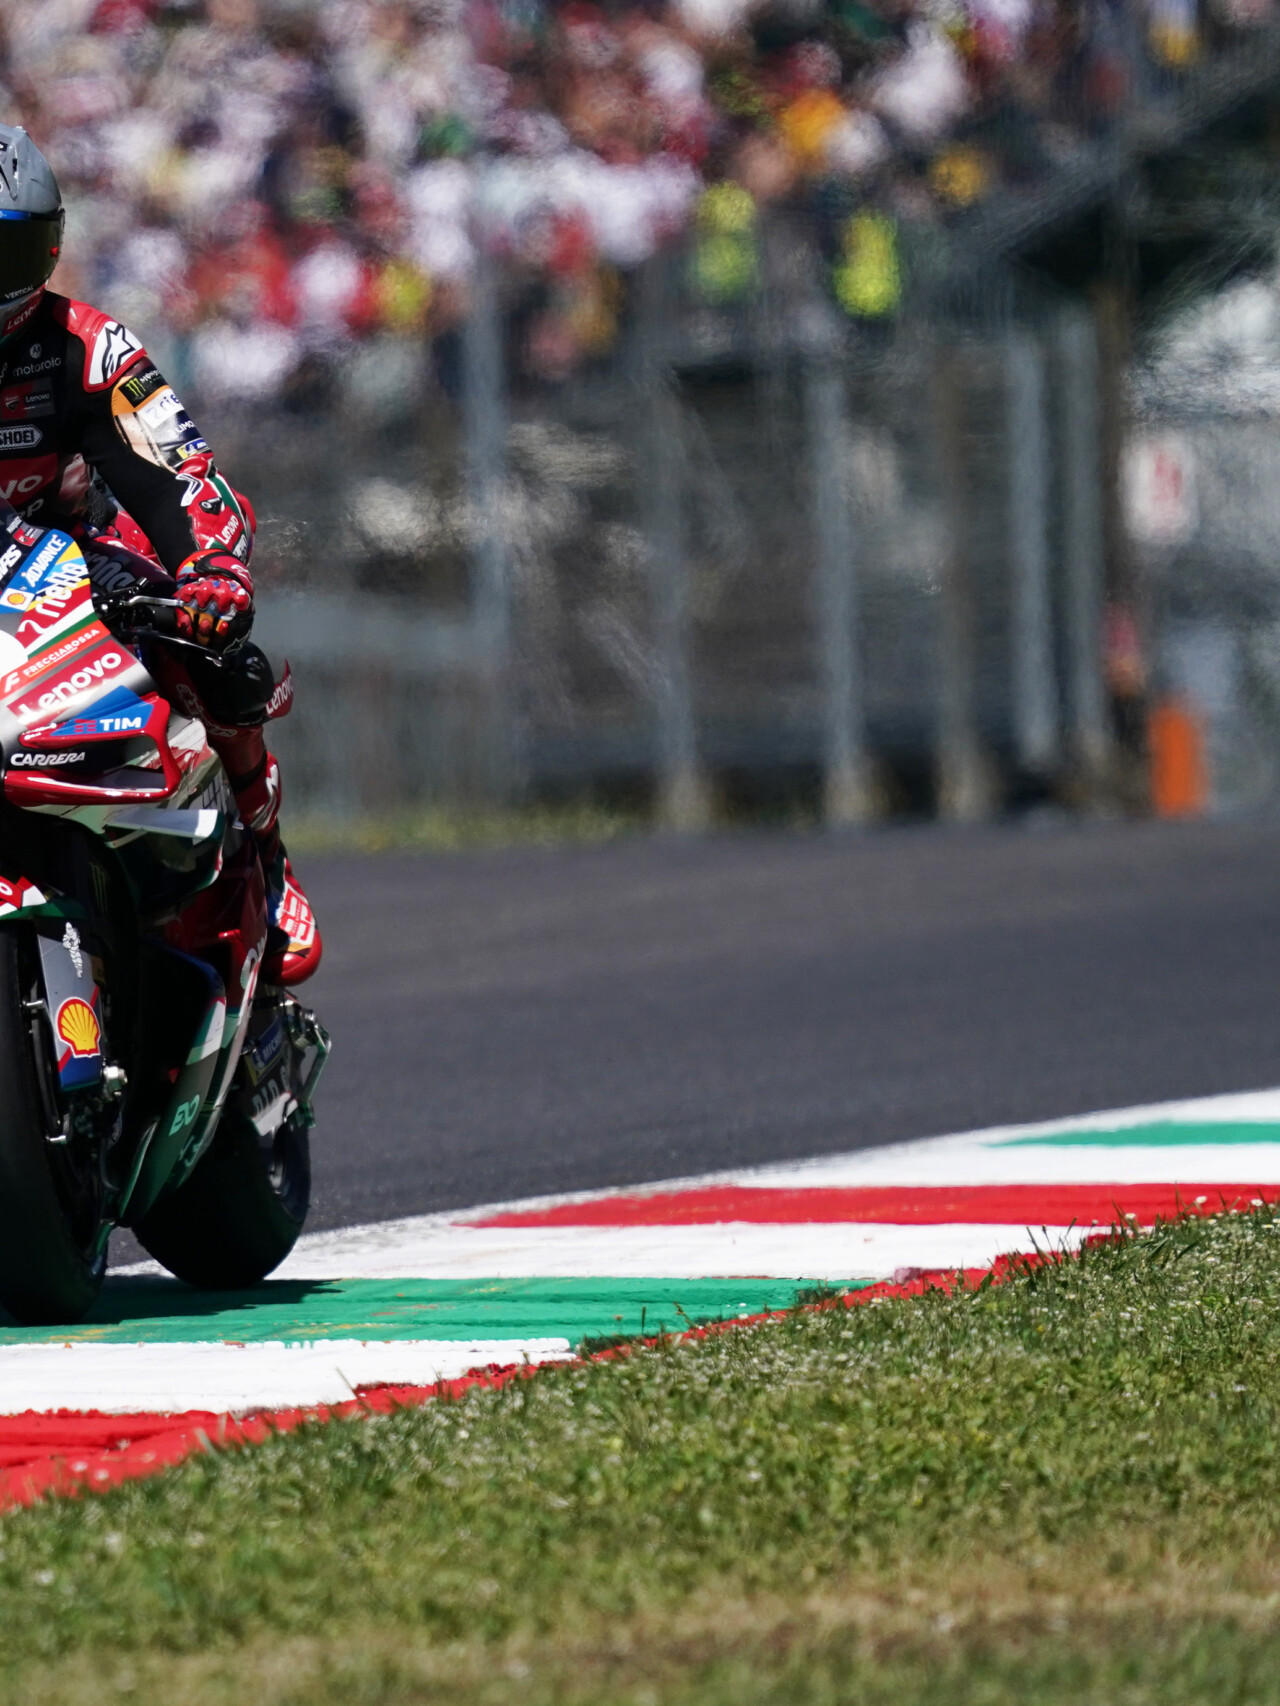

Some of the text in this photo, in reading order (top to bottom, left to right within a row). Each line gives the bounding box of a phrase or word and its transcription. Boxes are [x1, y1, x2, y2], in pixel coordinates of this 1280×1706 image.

[5, 285, 34, 299] VERTICAL
[13, 357, 62, 377] motorola
[24, 392, 51, 404] Lenovo
[215, 515, 240, 545] Lenovo
[25, 534, 67, 588] ADVANCE
[23, 629, 101, 677] FRECCIAROSSA
[18, 652, 122, 722] Lenovo
[266, 674, 294, 714] Lenov
[100, 717, 142, 731] TIM
[10, 751, 86, 766] CARRERA
